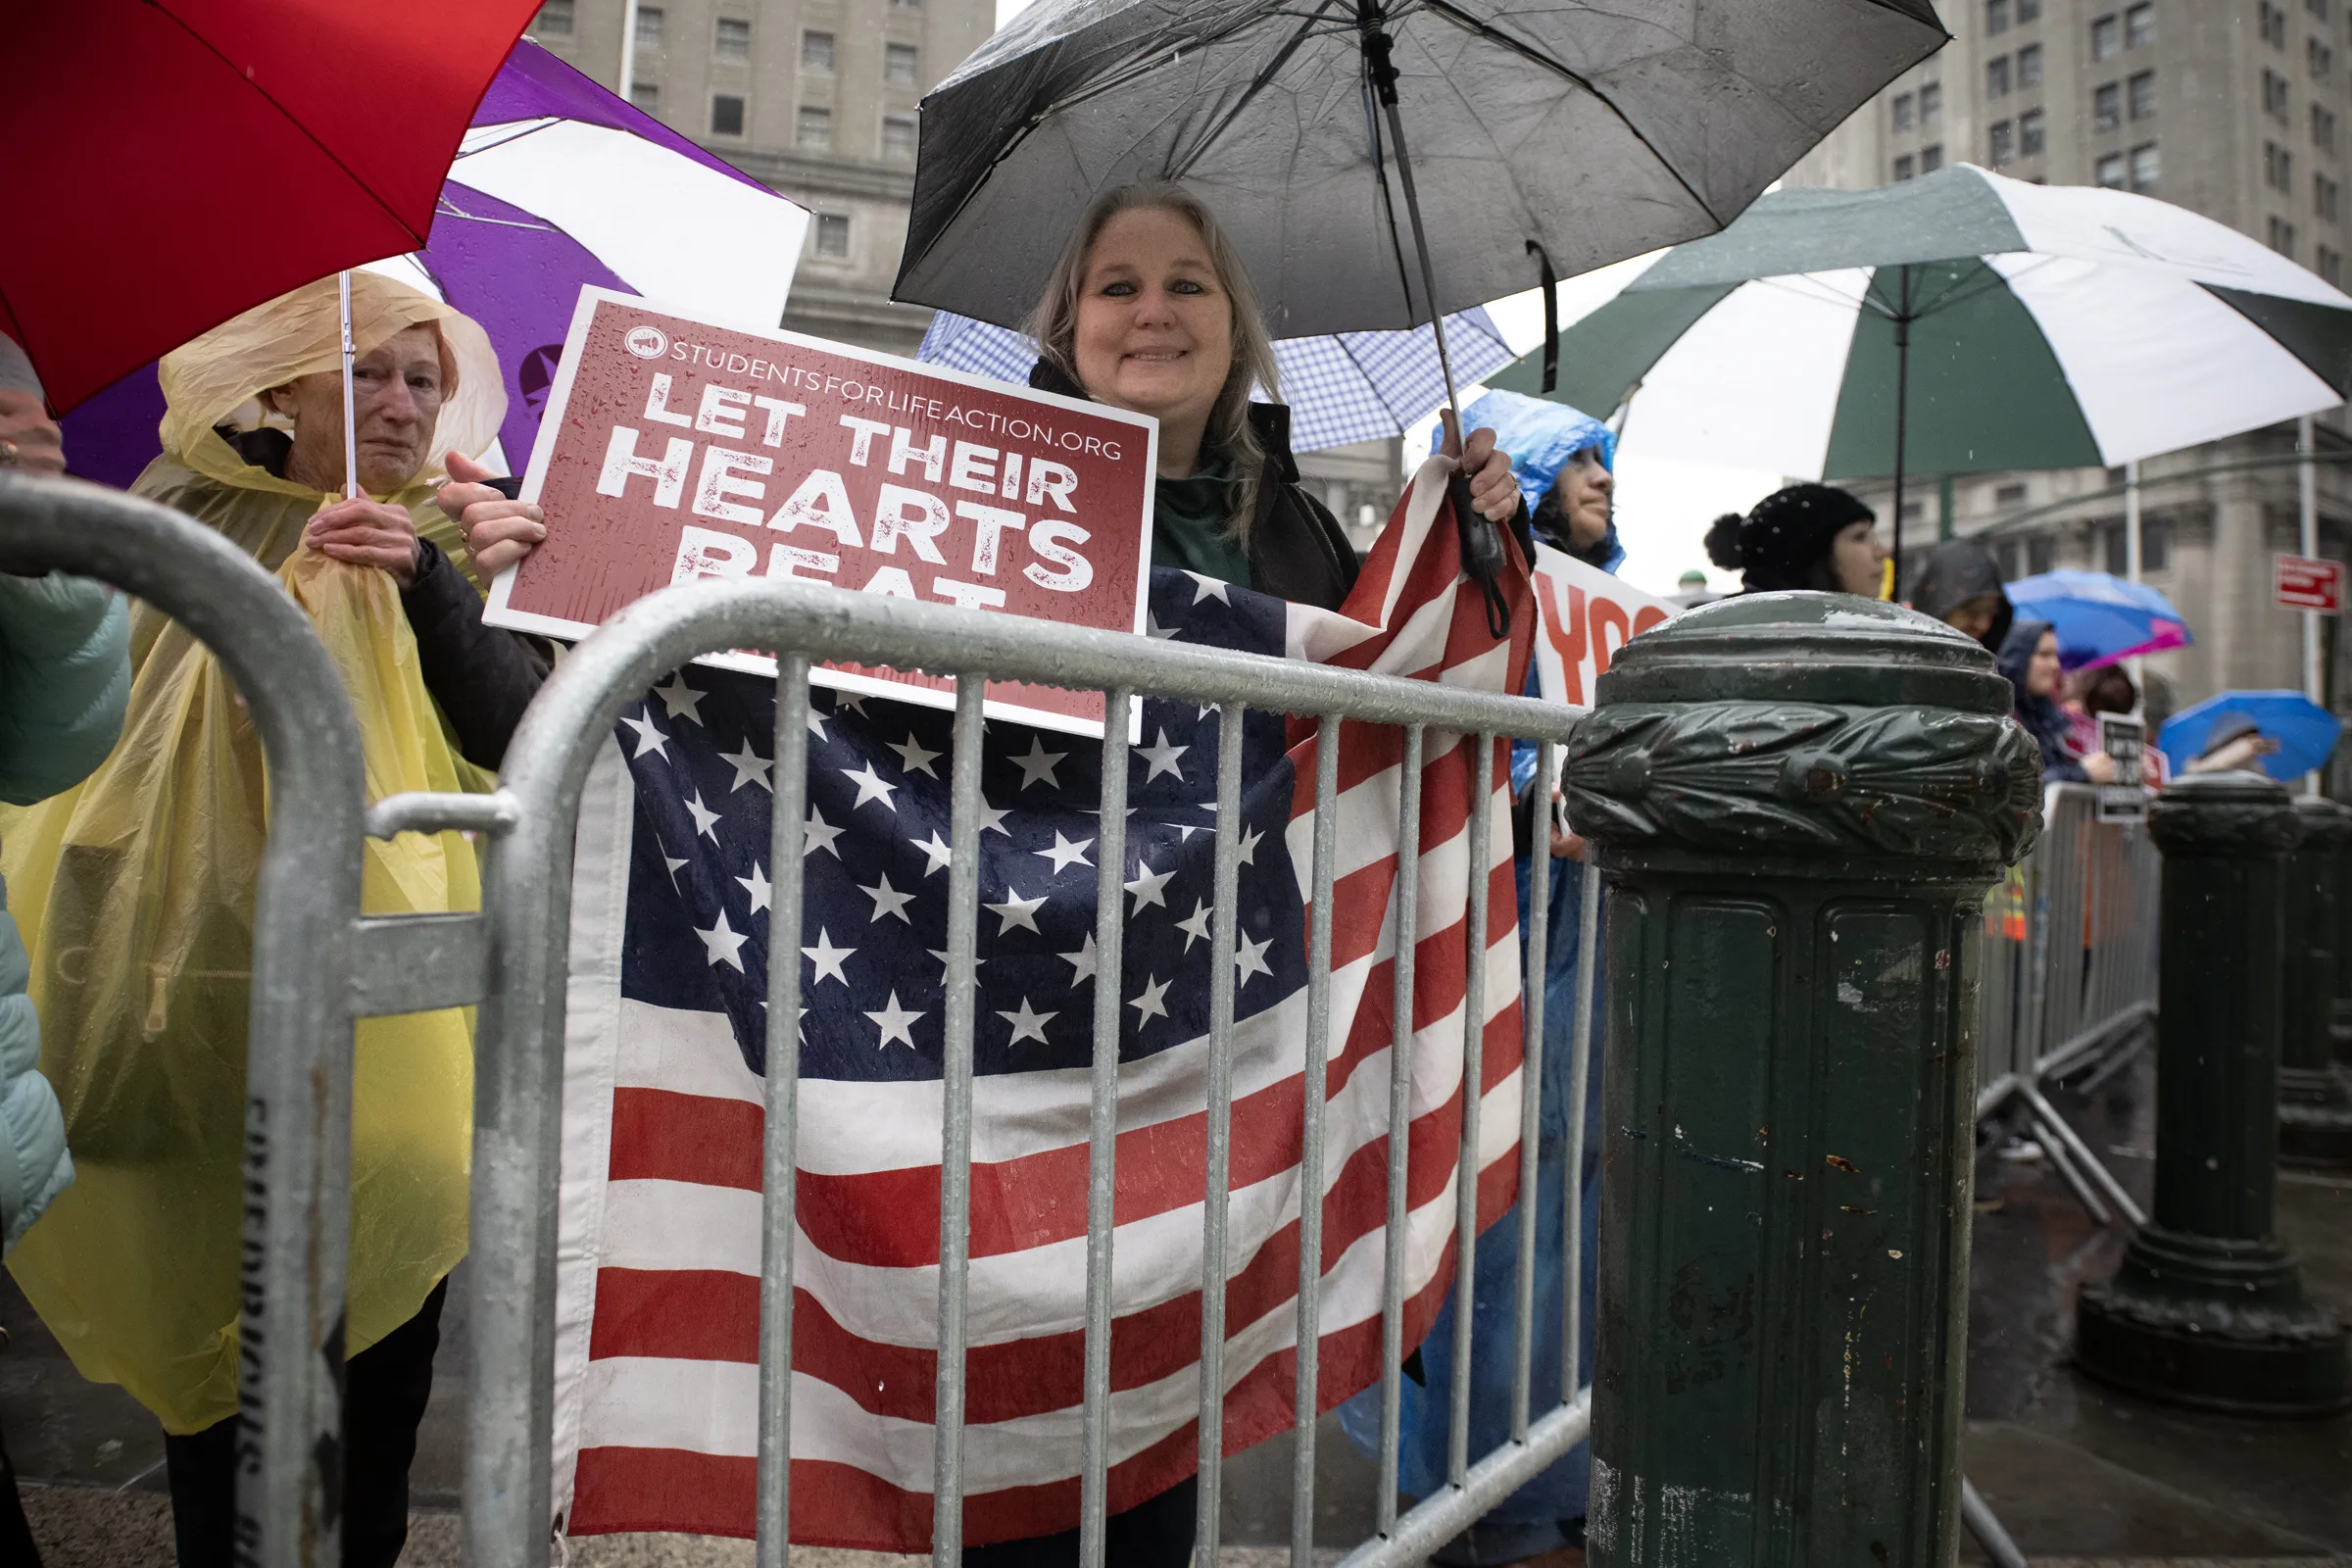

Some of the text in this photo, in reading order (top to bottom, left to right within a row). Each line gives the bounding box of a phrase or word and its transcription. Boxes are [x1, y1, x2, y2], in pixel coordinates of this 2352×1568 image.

[643, 371, 1079, 514] LET THEIR
[670, 341, 1122, 461] STUDENTSFORLIFEACTION.ORG
[596, 424, 1094, 593] HEARTS
